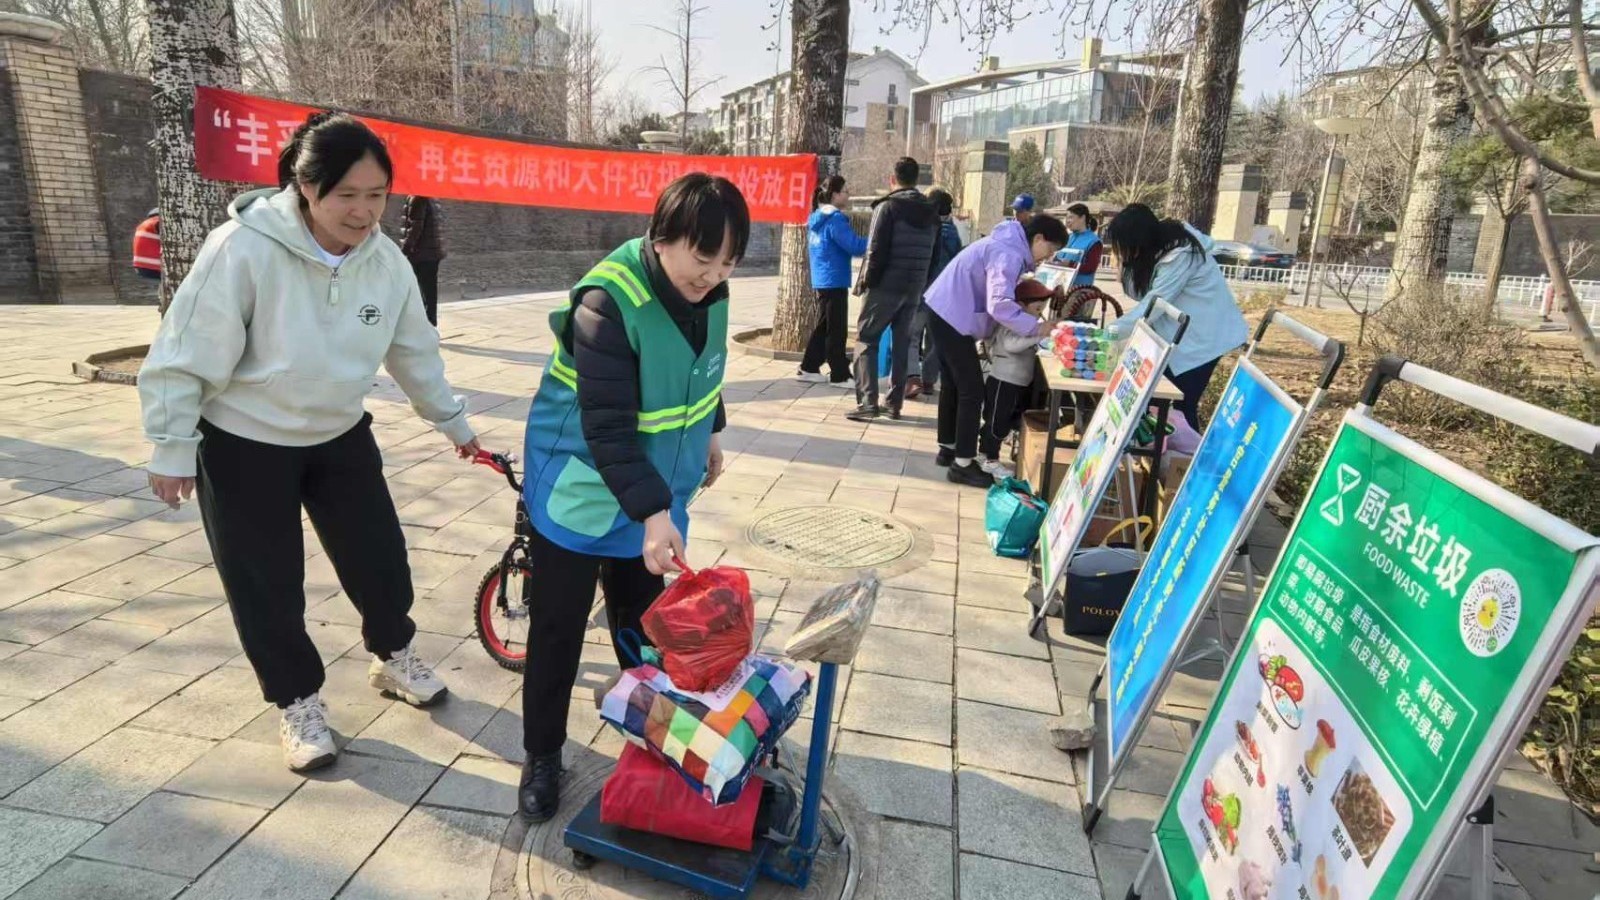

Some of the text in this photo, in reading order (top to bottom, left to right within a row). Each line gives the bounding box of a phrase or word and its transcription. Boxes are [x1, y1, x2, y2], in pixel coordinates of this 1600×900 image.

[1354, 482, 1474, 599] 厨余垃圾
[1362, 541, 1431, 610] FOOD WASTE
